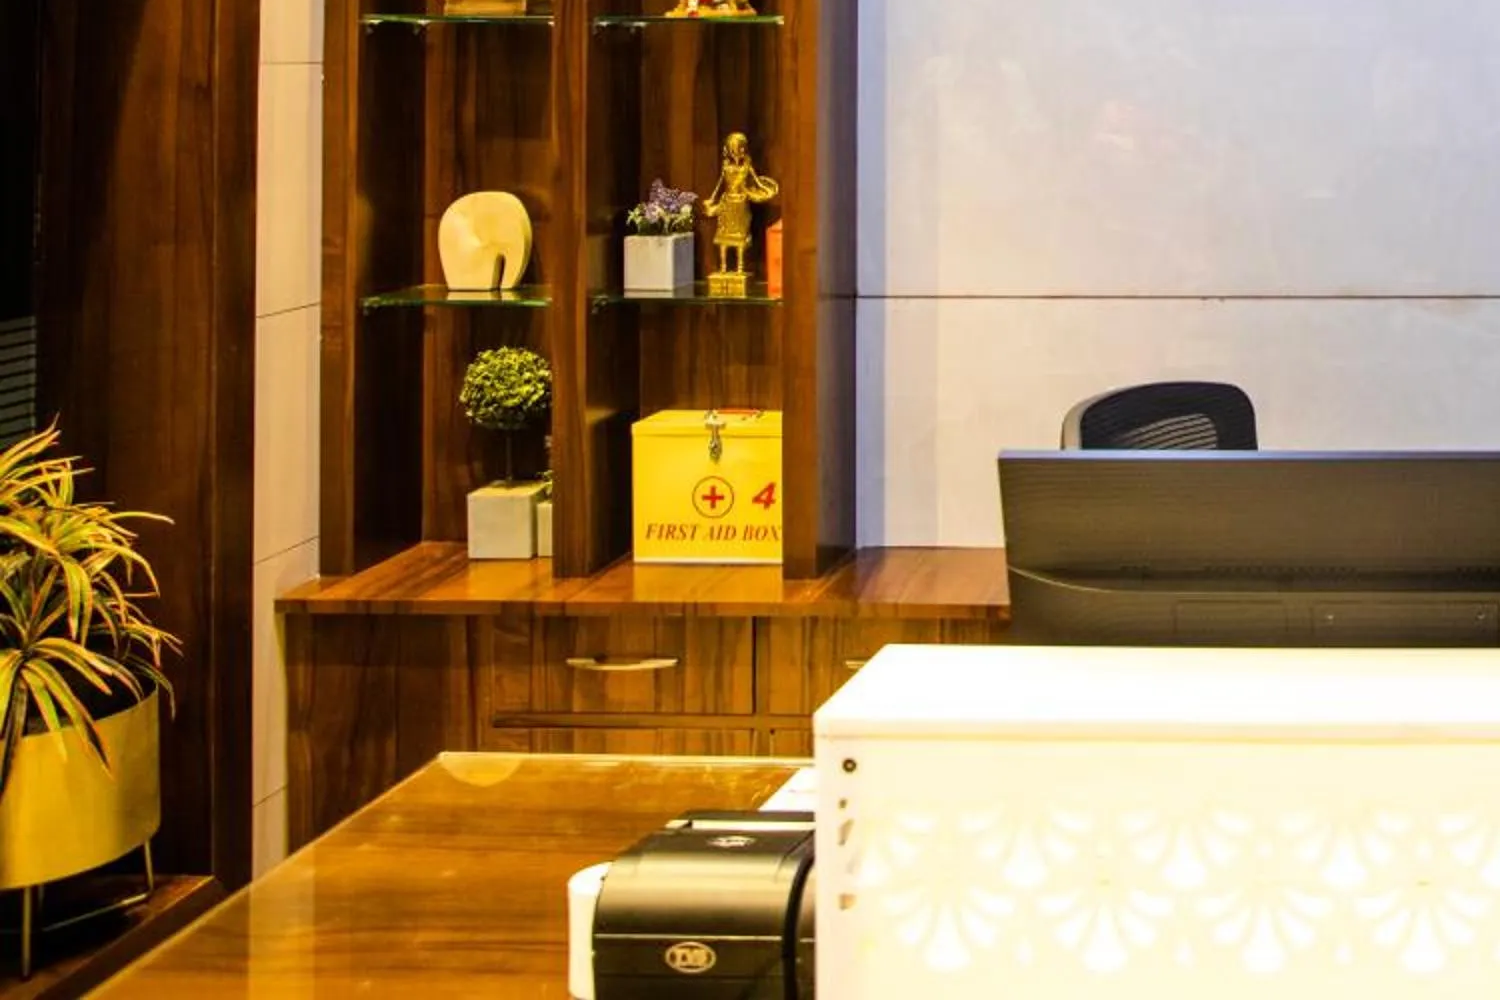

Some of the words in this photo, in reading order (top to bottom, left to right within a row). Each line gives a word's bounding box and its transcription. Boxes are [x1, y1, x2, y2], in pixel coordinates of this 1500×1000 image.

[752, 482, 776, 510] 4
[645, 522, 699, 541] FIRST
[703, 524, 737, 541] AID
